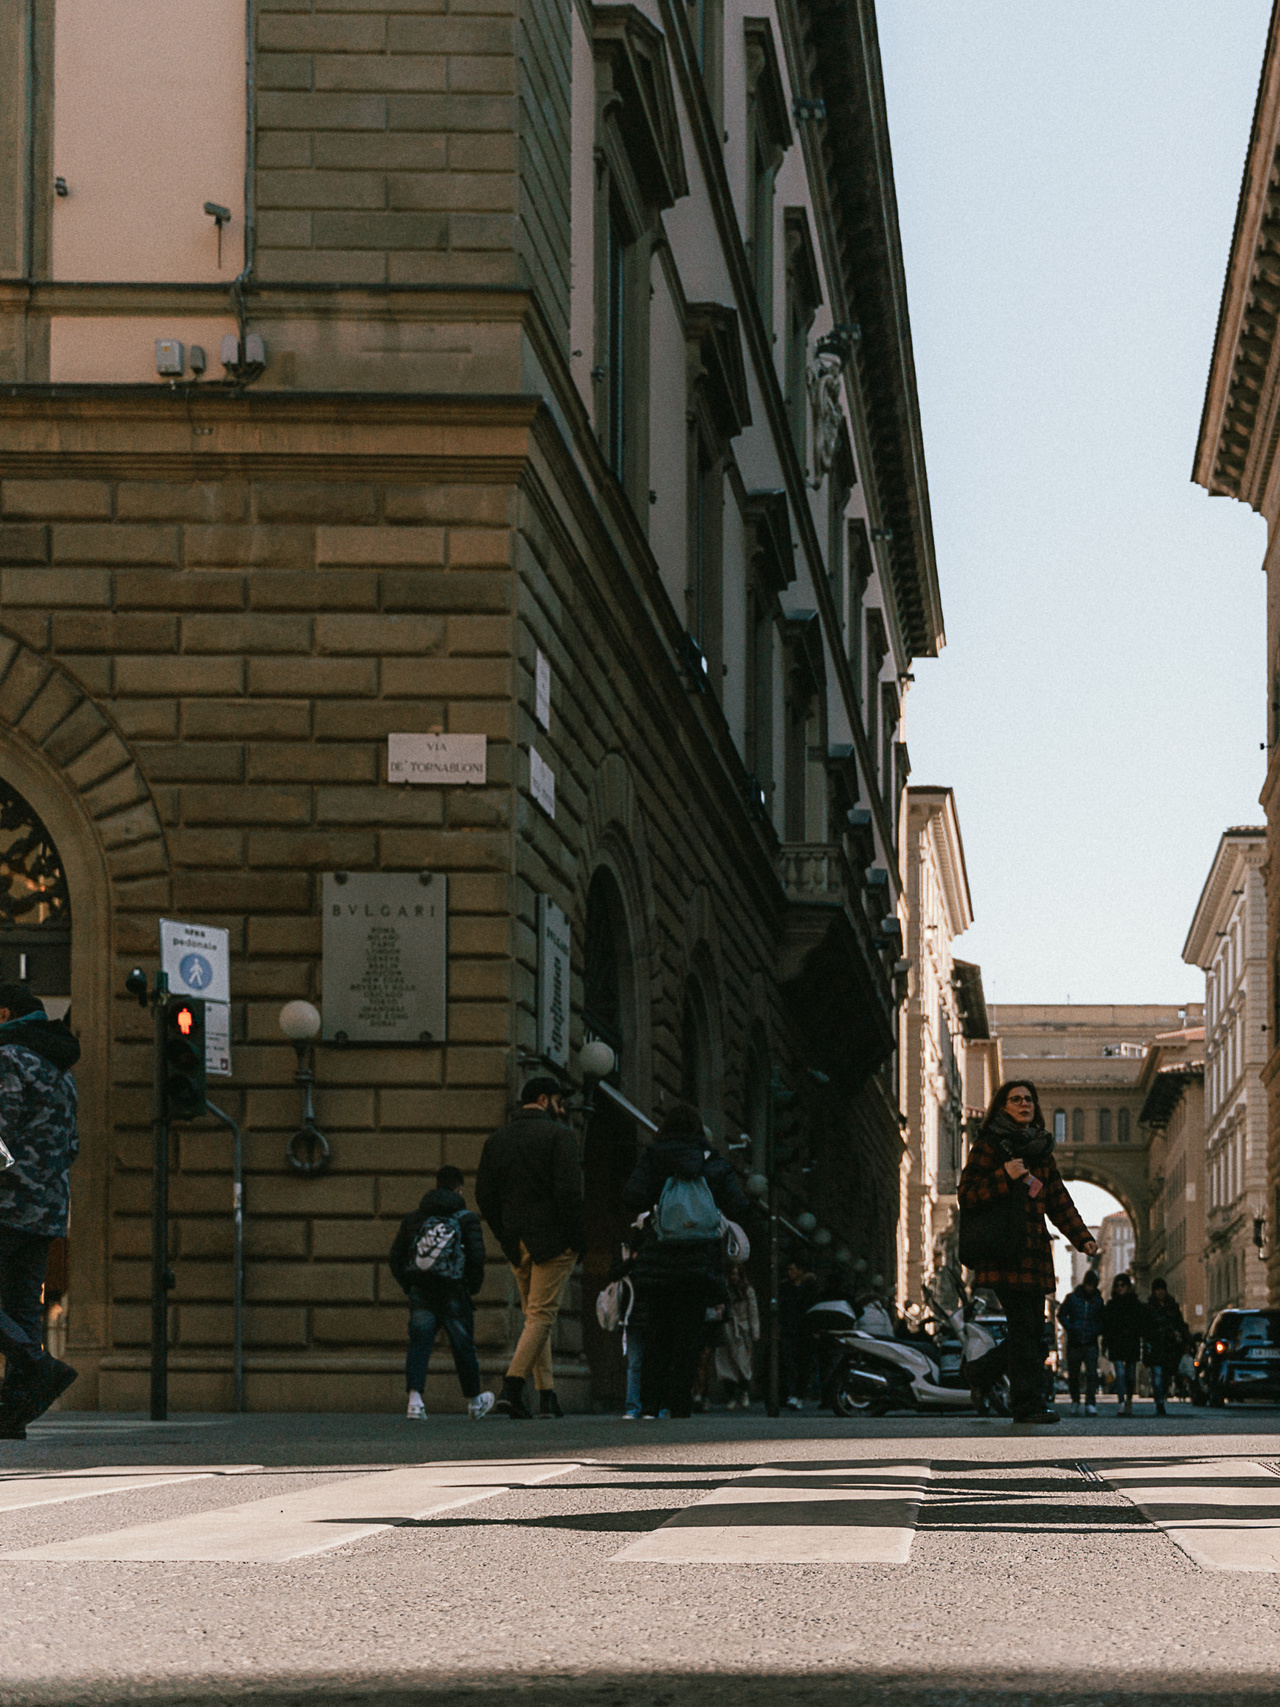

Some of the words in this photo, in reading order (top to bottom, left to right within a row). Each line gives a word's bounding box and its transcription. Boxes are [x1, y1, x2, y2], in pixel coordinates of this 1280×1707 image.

[426, 743, 447, 751] VIA
[410, 762, 484, 773] TORNABUONI
[332, 904, 435, 917] BVLGARI
